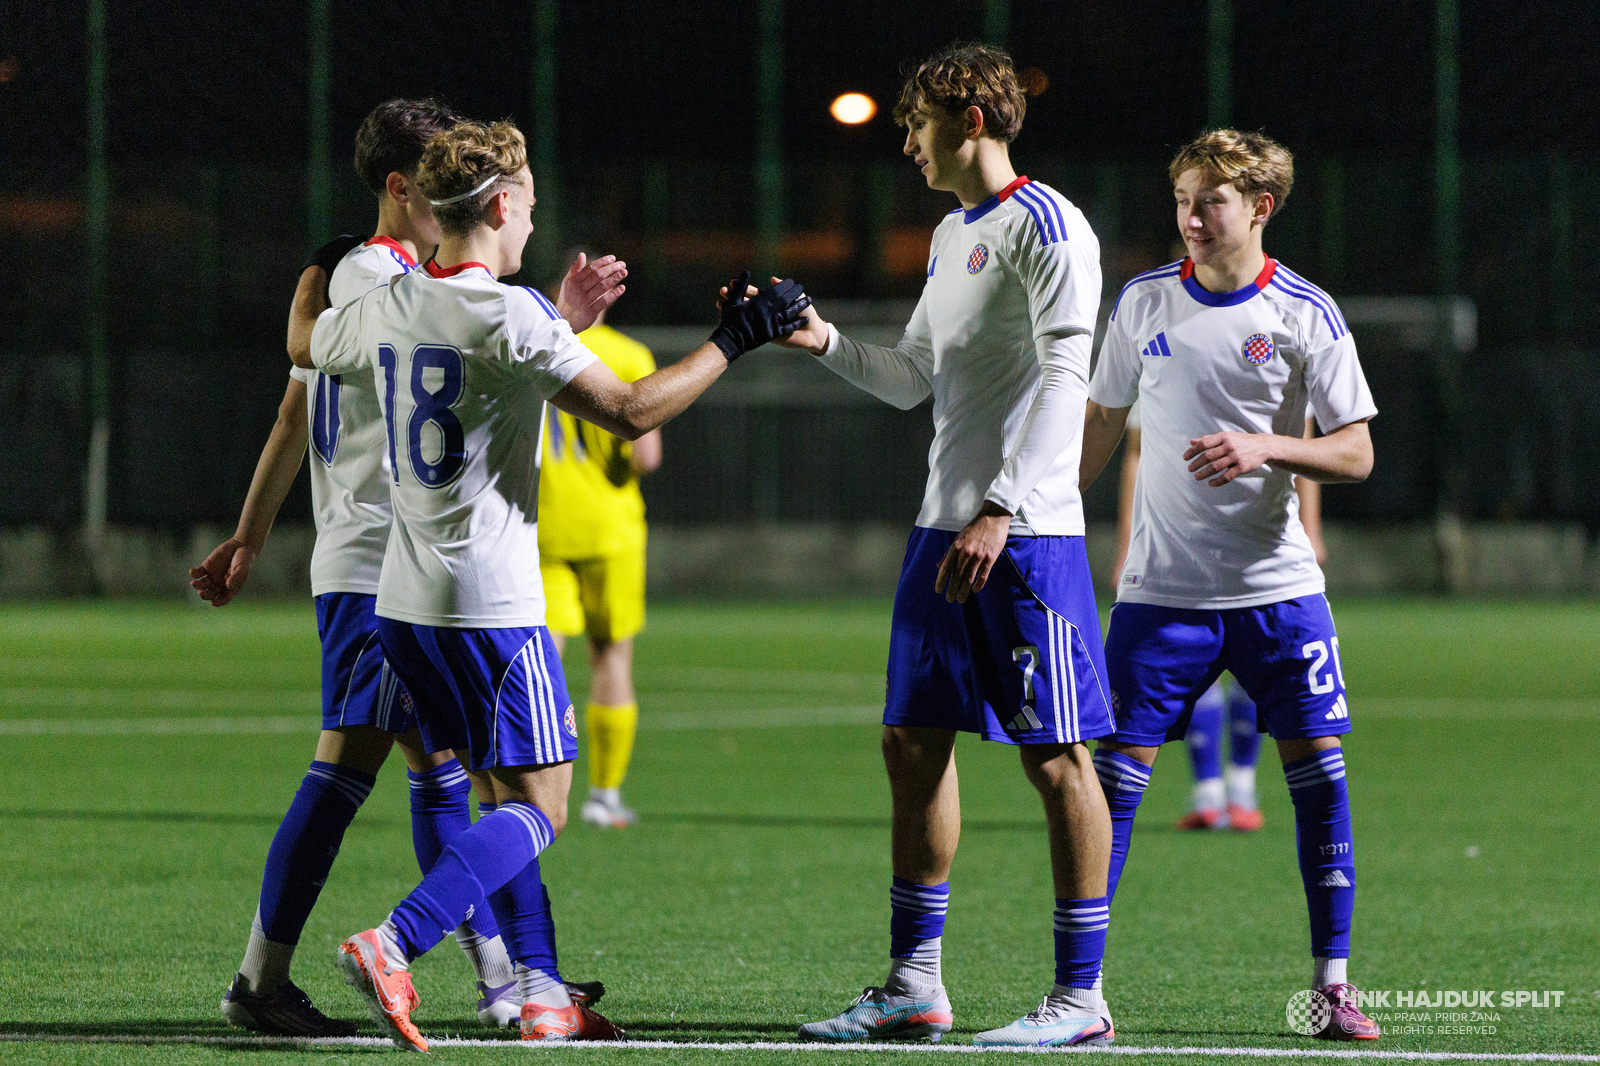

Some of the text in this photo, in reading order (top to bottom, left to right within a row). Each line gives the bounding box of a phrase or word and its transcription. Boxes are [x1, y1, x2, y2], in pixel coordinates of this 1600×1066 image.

[378, 342, 468, 489] 18
[1012, 645, 1040, 700] 7
[1319, 842, 1349, 856] 1911
